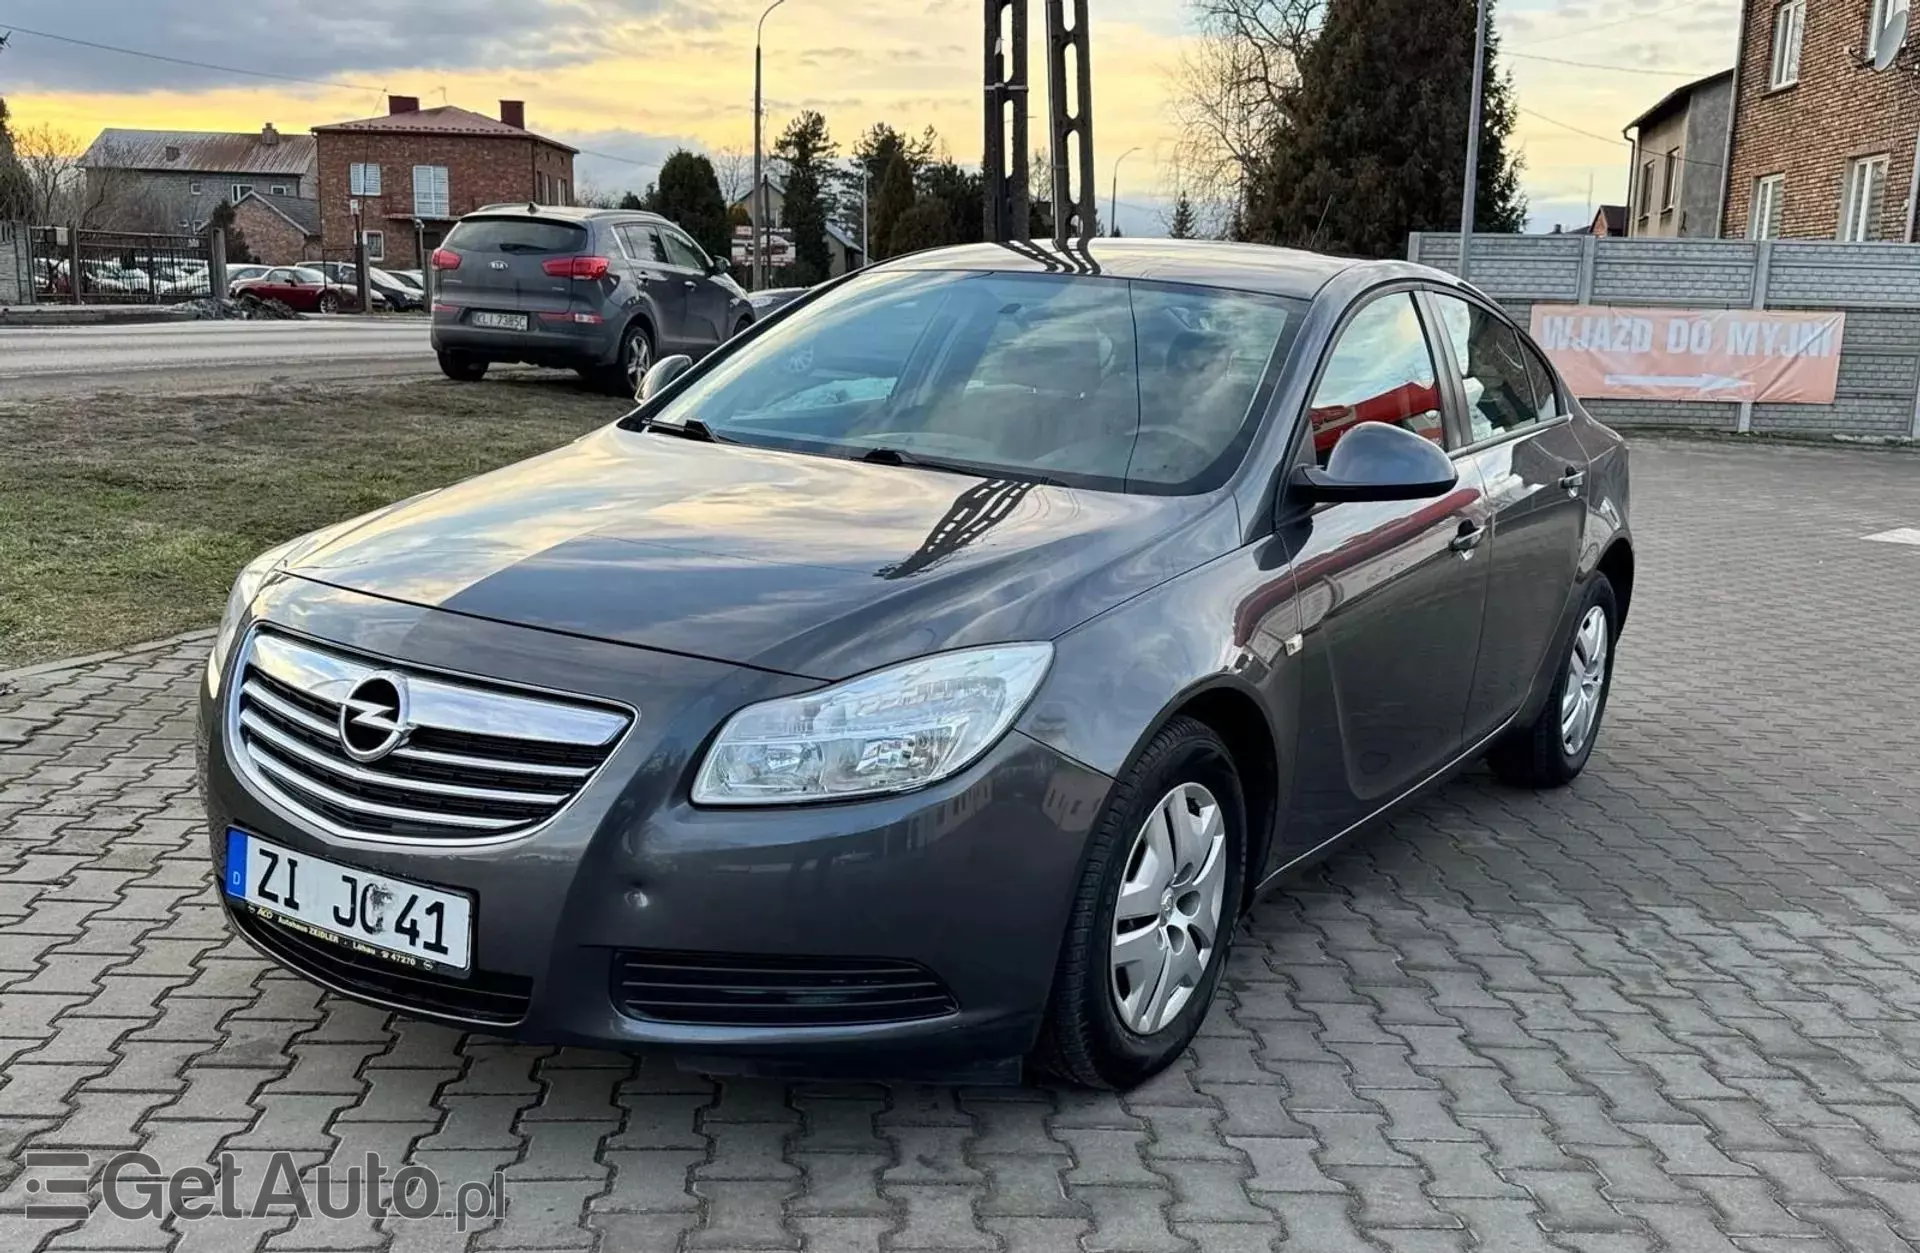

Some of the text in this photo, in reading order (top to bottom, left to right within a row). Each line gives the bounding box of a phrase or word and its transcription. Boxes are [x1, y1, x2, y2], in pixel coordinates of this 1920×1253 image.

[1541, 314, 1654, 353] WJAZD
[1666, 318, 1711, 354] DO
[232, 871, 241, 885] D
[257, 848, 300, 911] ZI
